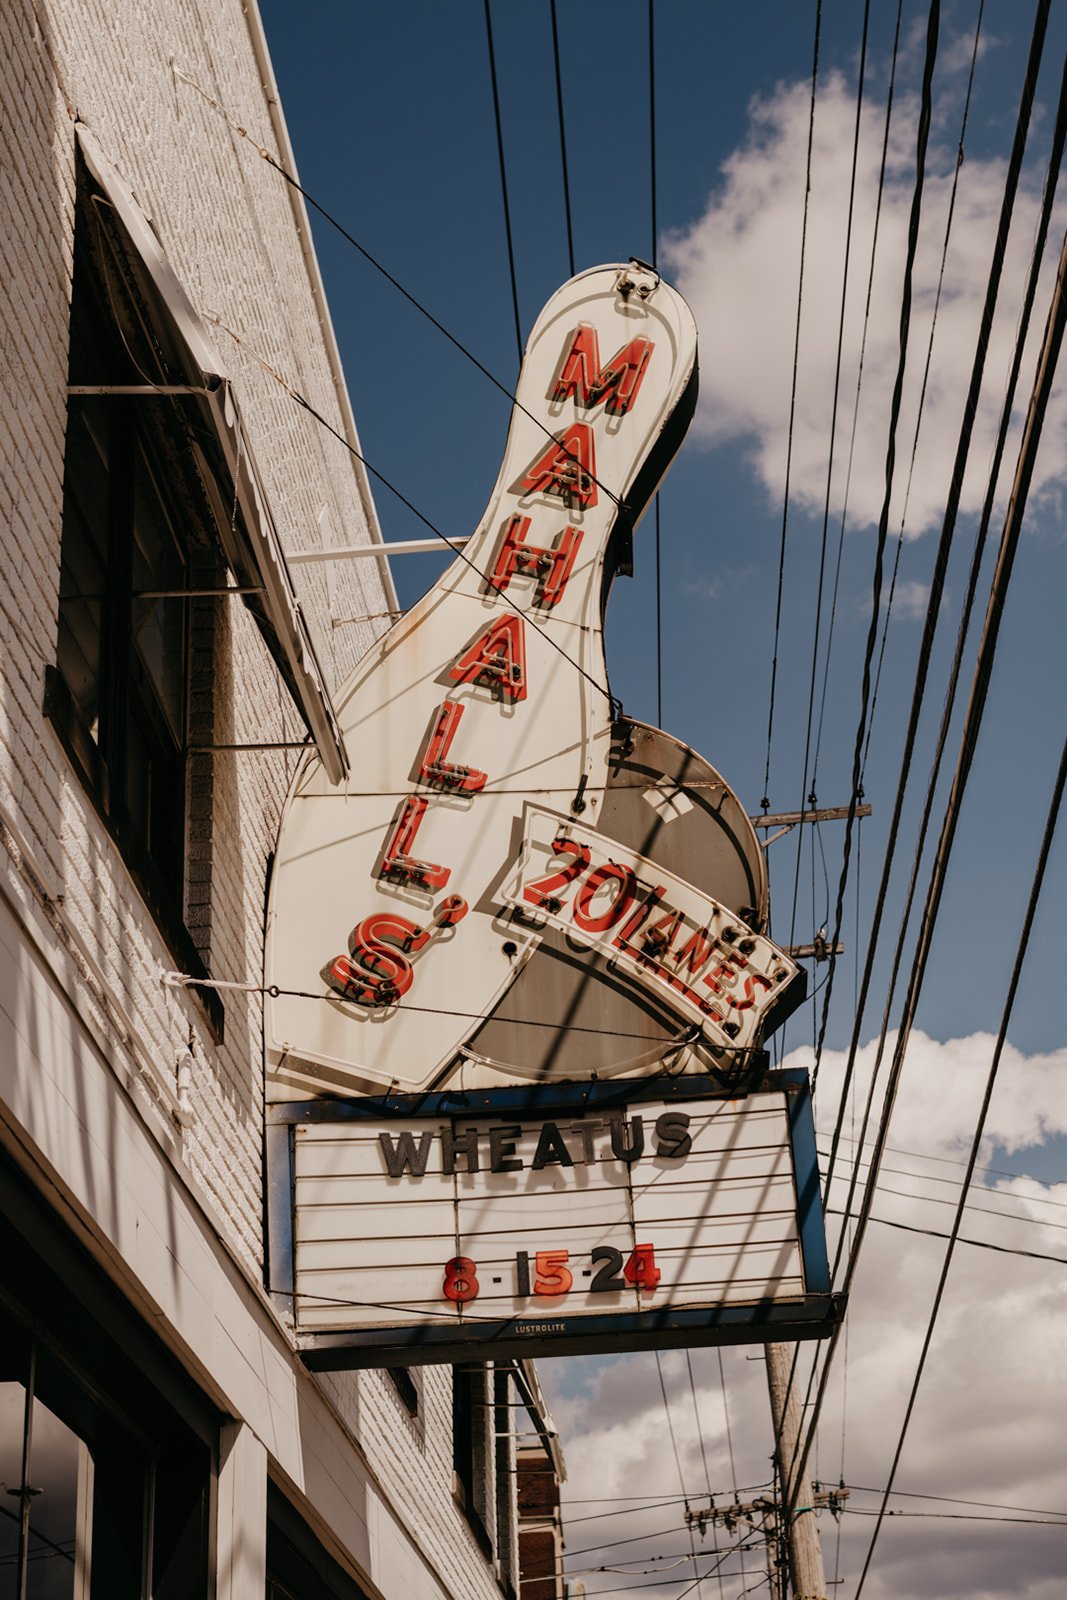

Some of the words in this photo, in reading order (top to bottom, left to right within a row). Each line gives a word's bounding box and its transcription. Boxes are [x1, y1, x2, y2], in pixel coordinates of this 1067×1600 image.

[522, 836, 637, 933] 20
[611, 884, 773, 1023] LANES
[379, 1112, 692, 1177] WHEATUS
[515, 1323, 566, 1334] LUSTROLITE
